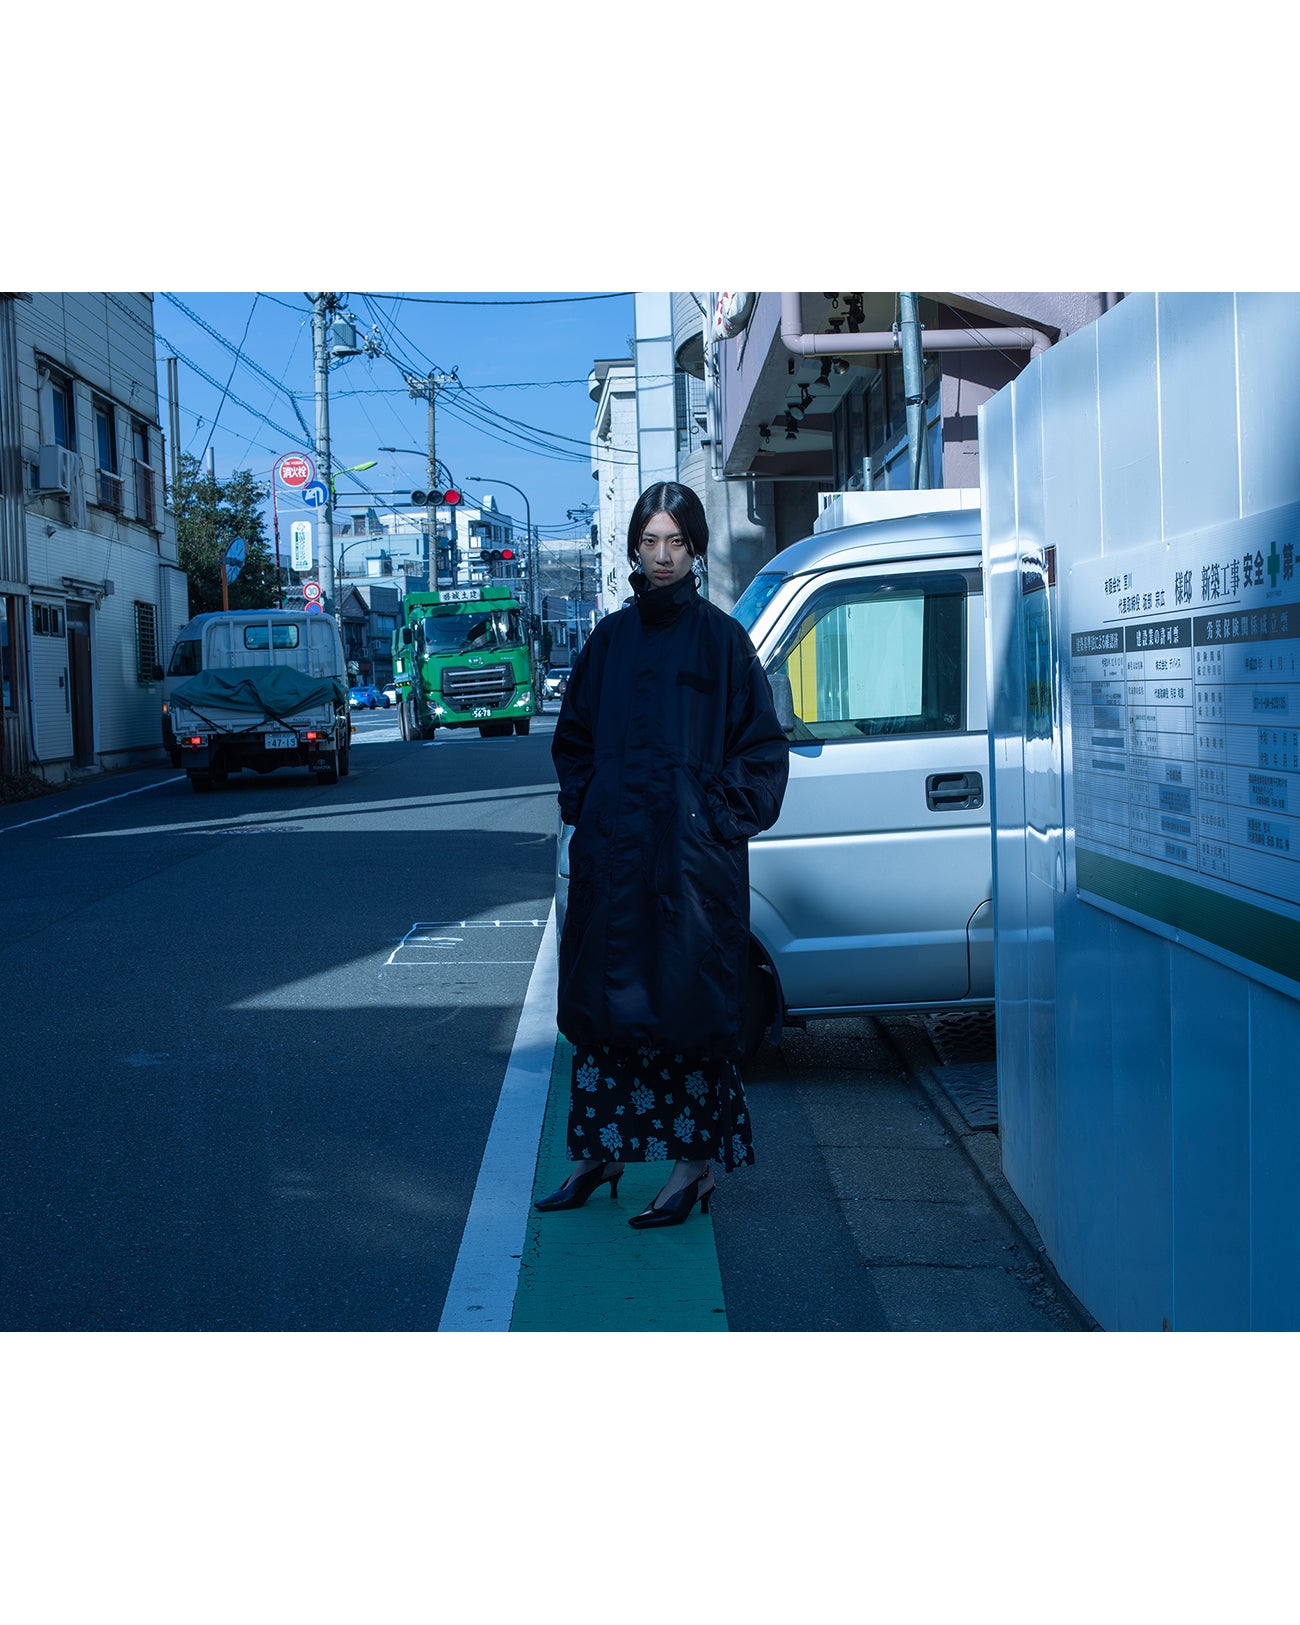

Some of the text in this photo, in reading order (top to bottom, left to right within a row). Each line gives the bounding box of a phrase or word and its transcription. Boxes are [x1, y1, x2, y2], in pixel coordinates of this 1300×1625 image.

[282, 465, 307, 479] 消火栓
[1243, 550, 1264, 588] 安全
[307, 587, 318, 596] 30
[1175, 559, 1240, 605] 様邸 新築工事
[1136, 626, 1179, 647] 建設業の許可票
[1206, 611, 1289, 640] 労災保険関係成立票
